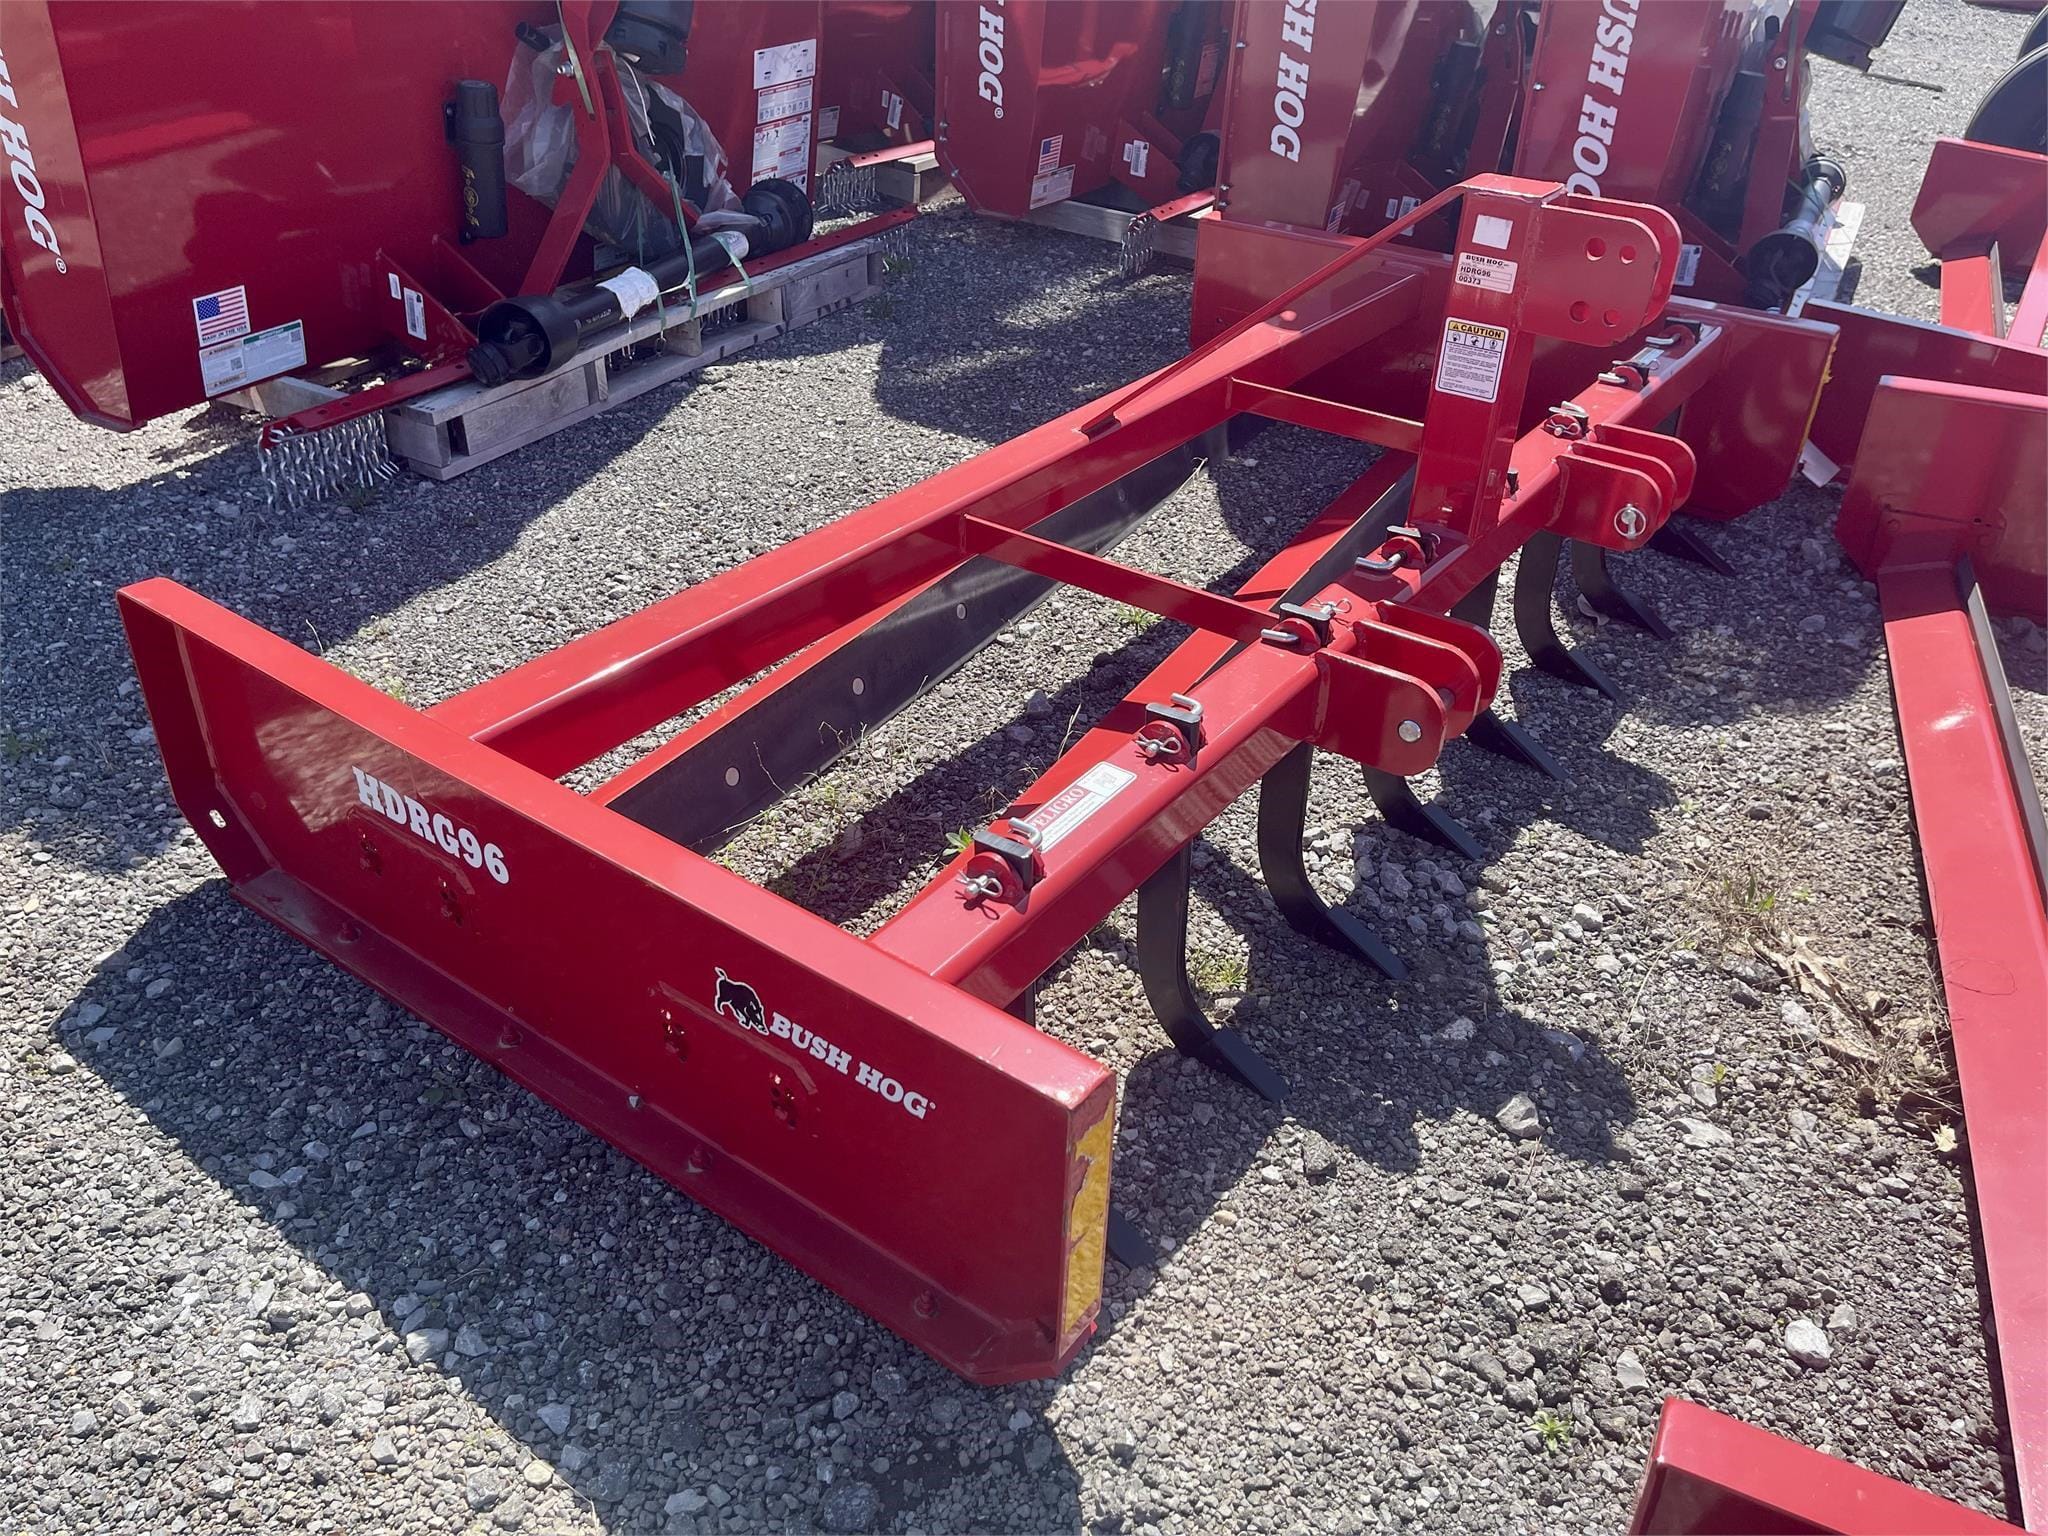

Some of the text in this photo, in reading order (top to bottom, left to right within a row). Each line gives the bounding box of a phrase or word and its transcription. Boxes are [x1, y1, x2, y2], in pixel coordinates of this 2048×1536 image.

[1270, 52, 1309, 163] HOG
[1460, 265, 1491, 277] HDRG96
[1466, 254, 1485, 263] BUSH
[1487, 258, 1504, 266] HOG
[1460, 324, 1502, 338] CAUTION
[352, 765, 510, 885] HDRG96
[769, 1011, 929, 1120] BUSH HOG
